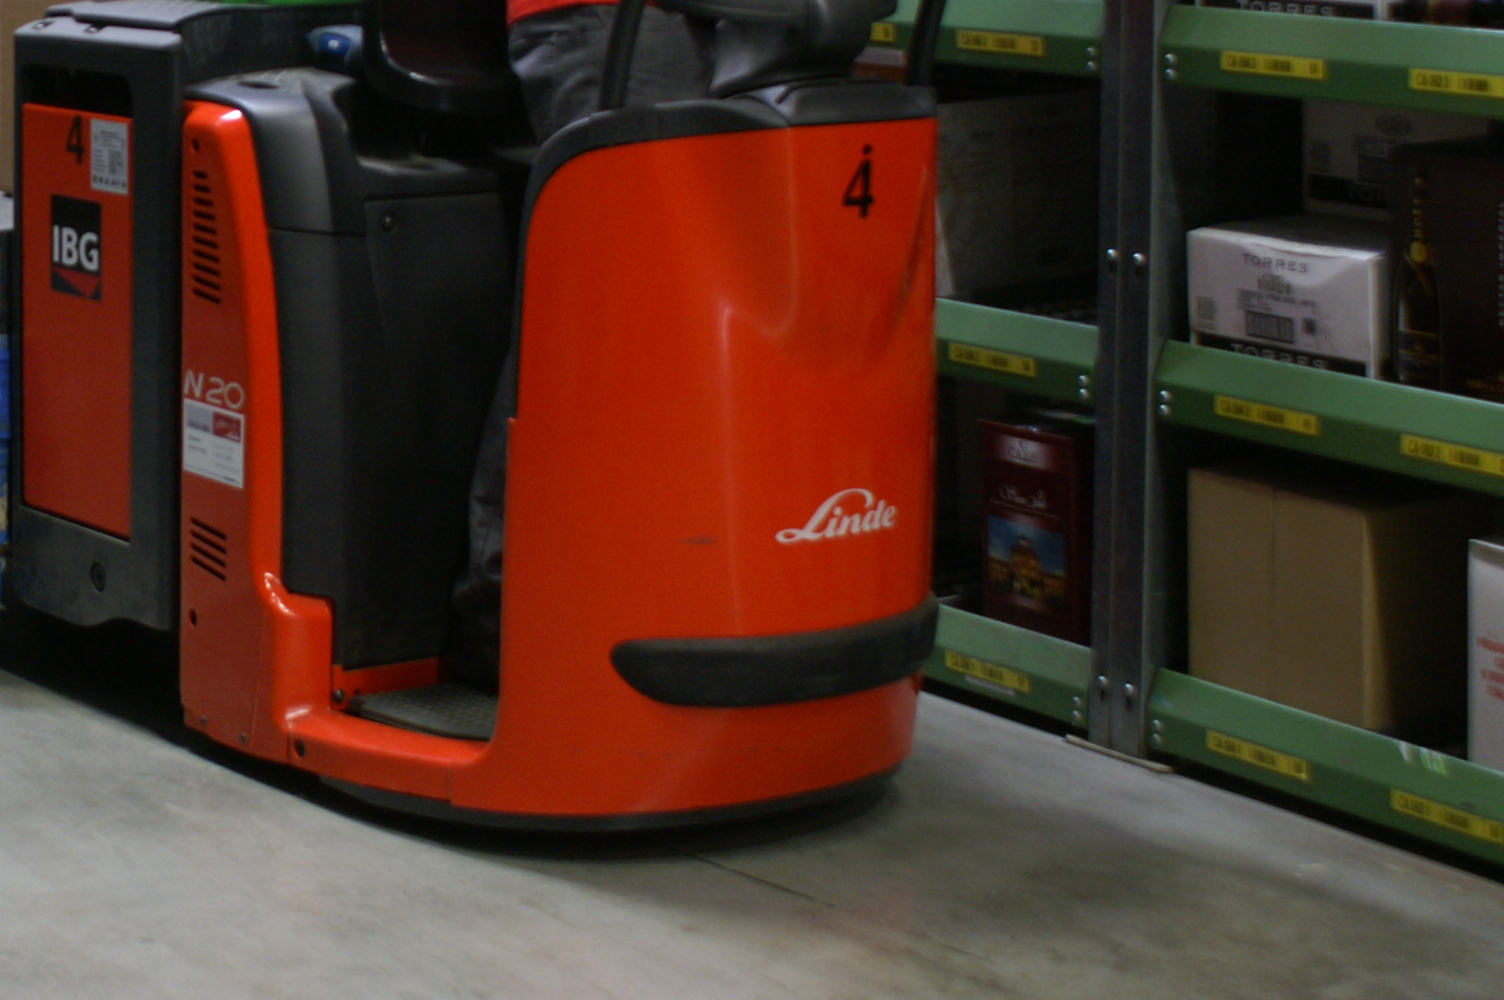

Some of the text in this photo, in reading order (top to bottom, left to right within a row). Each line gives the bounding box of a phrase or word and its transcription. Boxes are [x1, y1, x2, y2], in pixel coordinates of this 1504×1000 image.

[66, 115, 84, 164] 4
[842, 159, 874, 218] 4
[52, 224, 100, 272] IBG
[1241, 253, 1311, 274] TORRES
[774, 487, 898, 544] Linde
